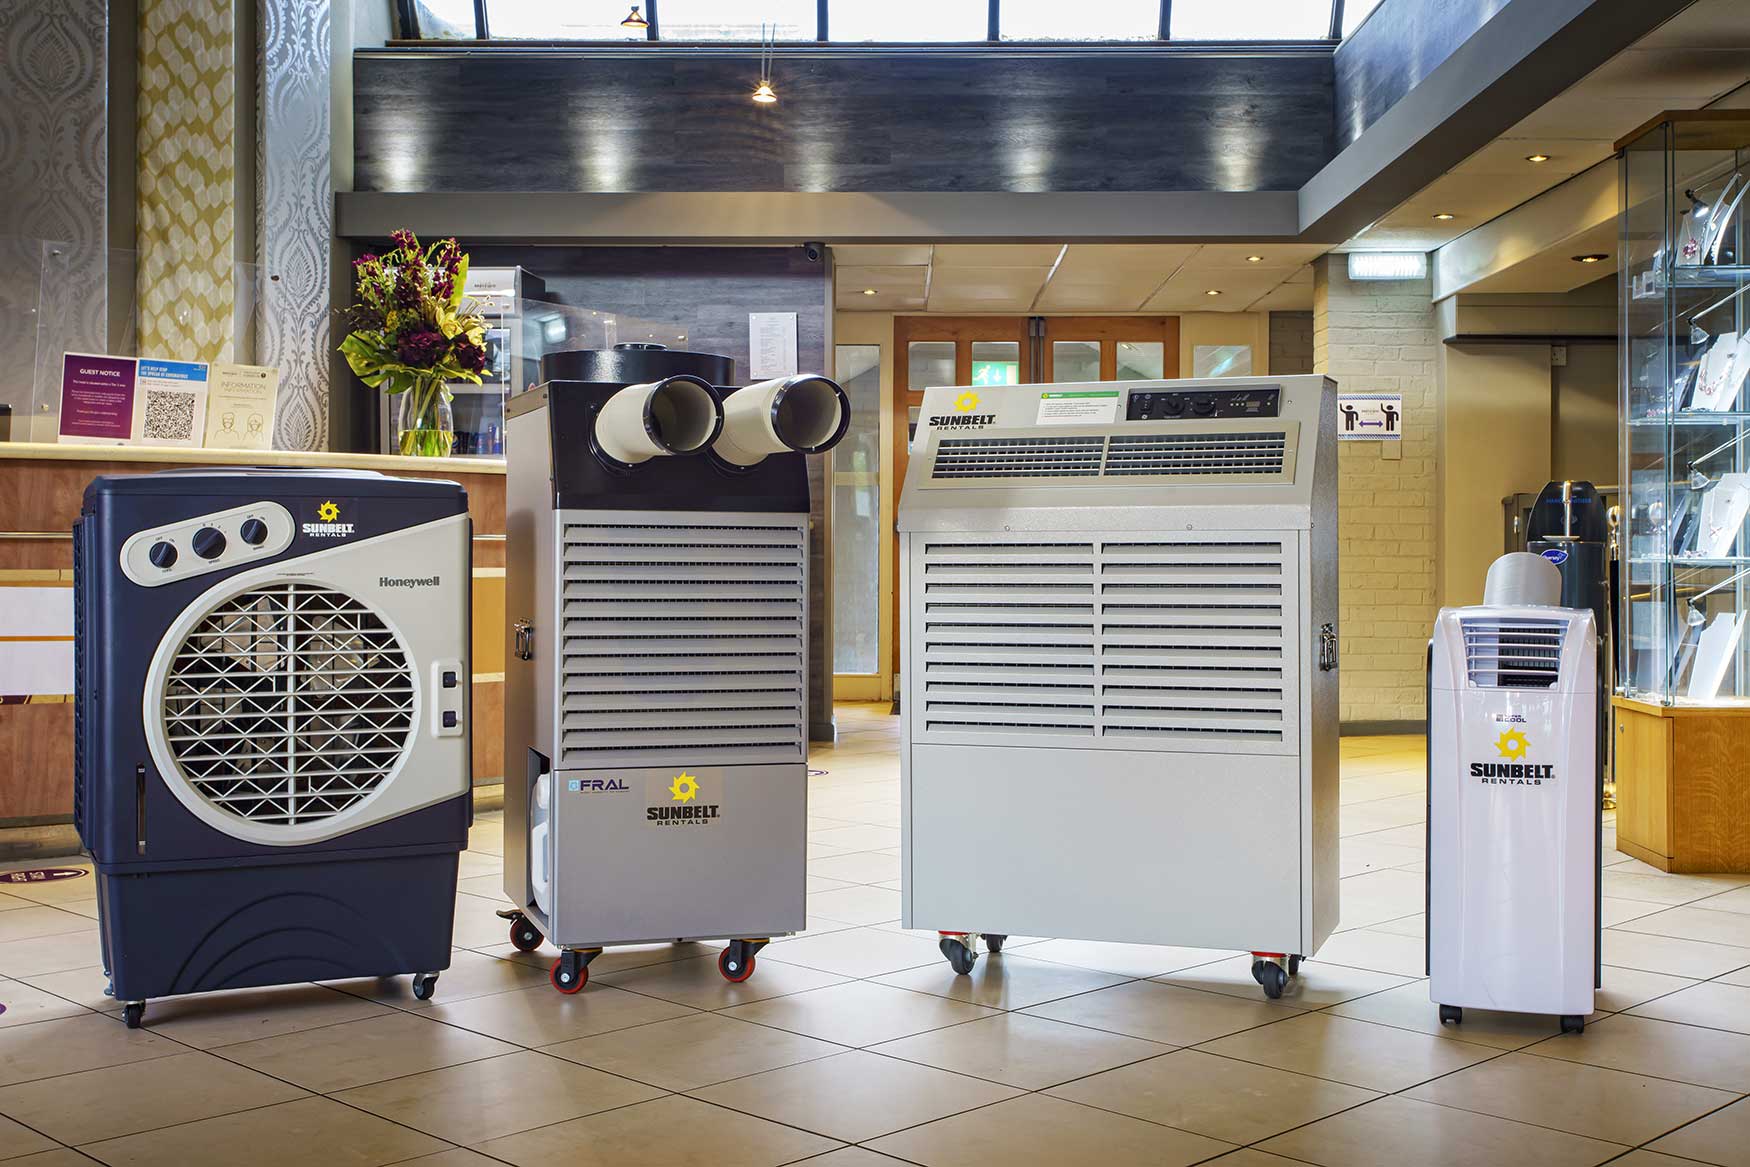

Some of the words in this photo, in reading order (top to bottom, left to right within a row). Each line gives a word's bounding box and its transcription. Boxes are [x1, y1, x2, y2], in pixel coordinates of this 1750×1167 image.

[929, 414, 996, 426] SUNBELT
[302, 524, 354, 533] SUNBELT
[380, 576, 440, 588] Honeywell
[1470, 763, 1553, 778] SUNBELT
[580, 779, 630, 790] FRAL
[647, 806, 719, 820] SUNBELT
